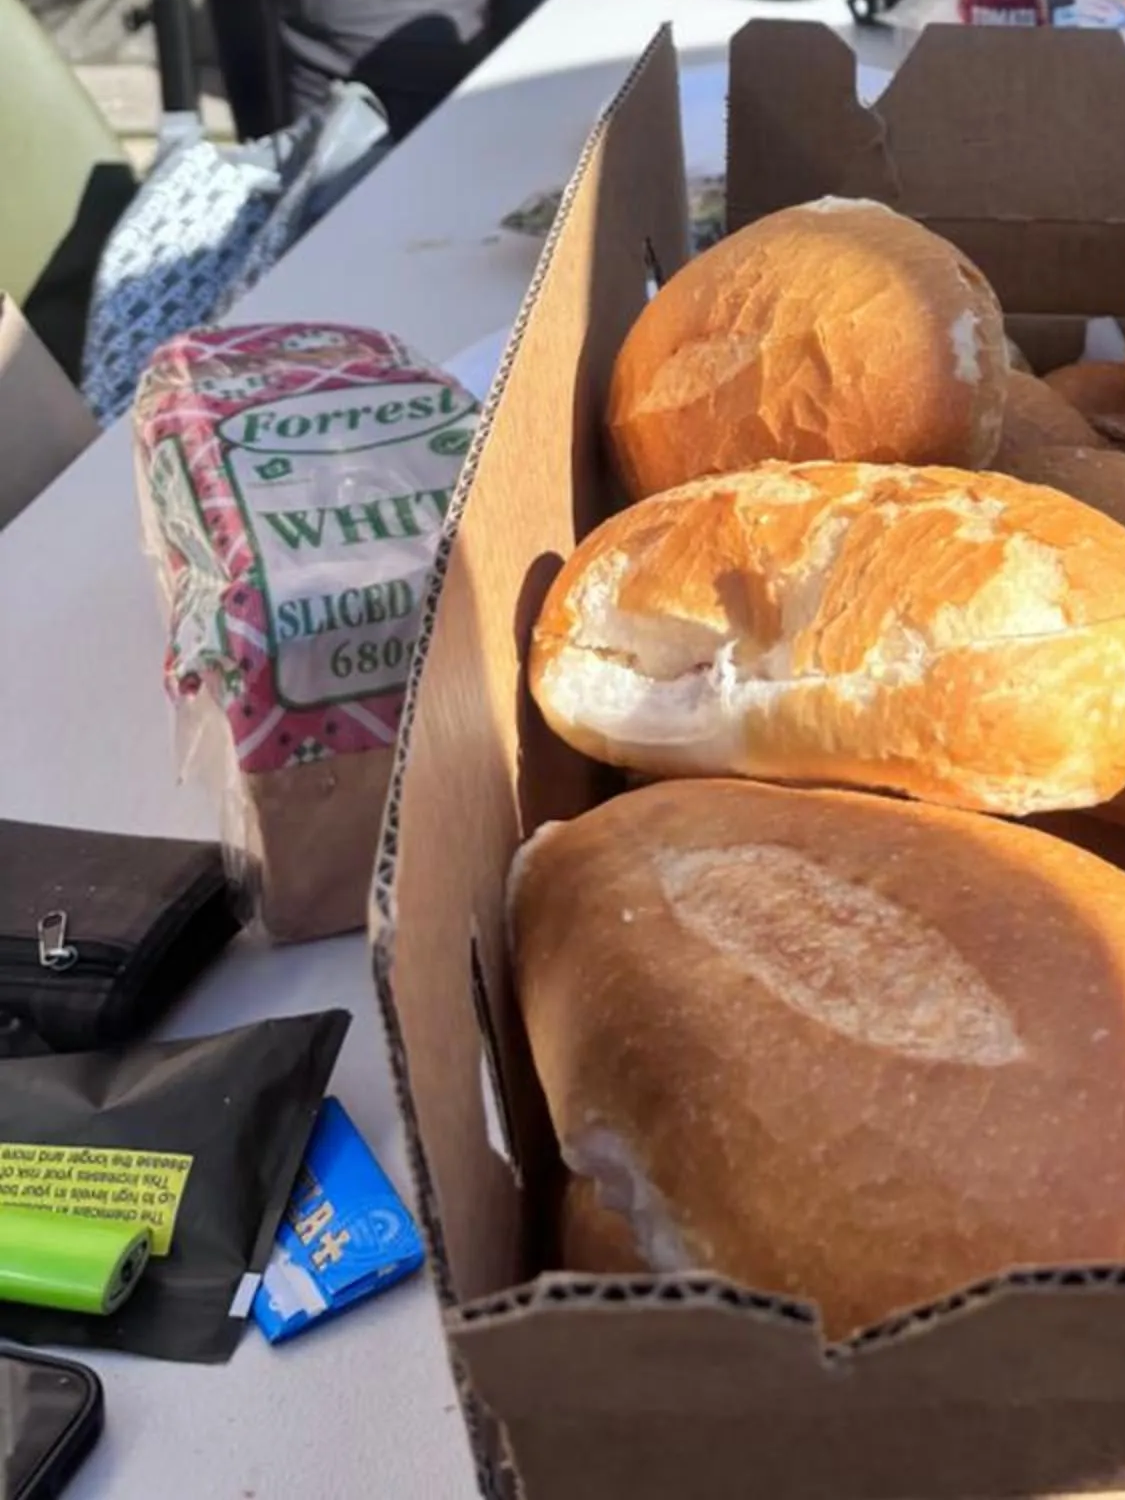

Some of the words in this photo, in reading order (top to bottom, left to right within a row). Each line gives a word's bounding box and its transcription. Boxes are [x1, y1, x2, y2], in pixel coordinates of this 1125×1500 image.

[240, 387, 457, 443] Forrest
[277, 578, 413, 640] SLICED
[38, 1150, 65, 1163] and
[67, 1149, 109, 1165] longer
[110, 1153, 135, 1168] the
[136, 1155, 190, 1170] disease
[17, 1167, 42, 1179] risk
[44, 1166, 73, 1181] your
[77, 1169, 138, 1184] increases
[142, 1172, 169, 1190] This
[21, 1184, 50, 1198] your
[55, 1186, 67, 1199] in
[69, 1186, 108, 1202] levels
[112, 1186, 139, 1202] high
[141, 1189, 155, 1201] to
[140, 1208, 164, 1226] The
